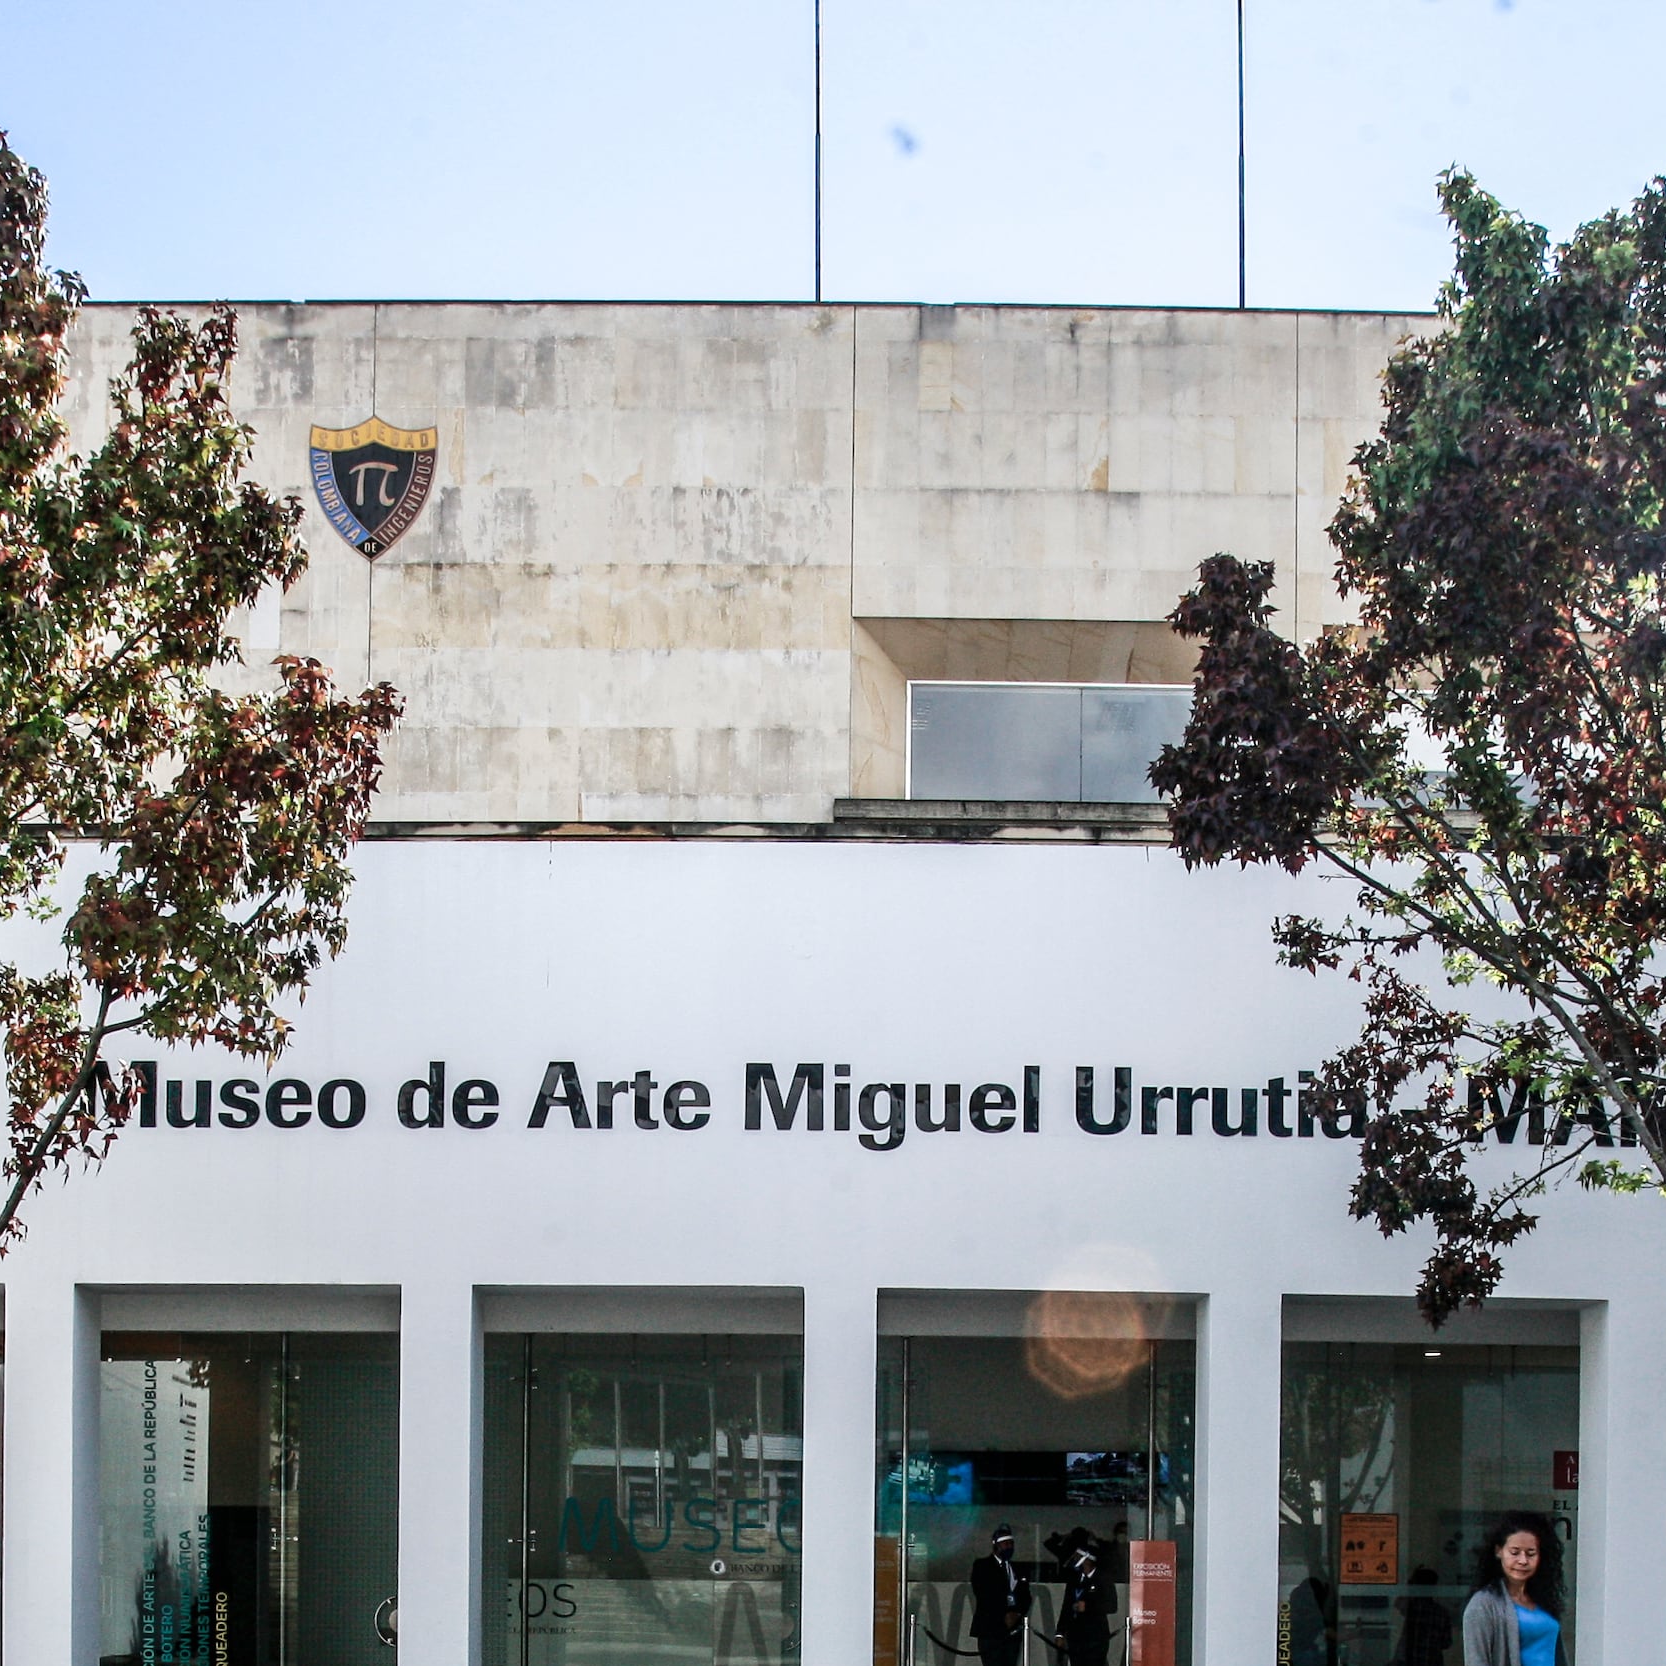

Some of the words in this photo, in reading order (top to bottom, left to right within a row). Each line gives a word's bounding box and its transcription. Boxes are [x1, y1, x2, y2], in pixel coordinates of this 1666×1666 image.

[317, 422, 429, 449] SOCIEDAD
[312, 453, 362, 543] COLOMBIANA
[379, 455, 434, 543] INGENIEROS
[364, 542, 378, 554] DE
[80, 1060, 366, 1129] Museo
[398, 1061, 499, 1129] de
[527, 1062, 710, 1130] Arte
[745, 1063, 1040, 1151] Miguel
[1076, 1066, 1367, 1138] Urrutia
[141, 1360, 157, 1439] REPÚBLICA
[144, 1442, 157, 1461] LA
[144, 1465, 157, 1484] DE
[144, 1488, 157, 1539] BANCO
[176, 1530, 191, 1634] NUMISMÁTICA
[196, 1514, 211, 1612] TEMPORALES
[1132, 1570, 1174, 1578] PERMANENTE
[142, 1573, 156, 1612] ARTE
[507, 1583, 577, 1618] OS
[143, 1614, 156, 1634] DE
[1132, 1608, 1158, 1617] Museo
[161, 1604, 173, 1663] BOTERO
